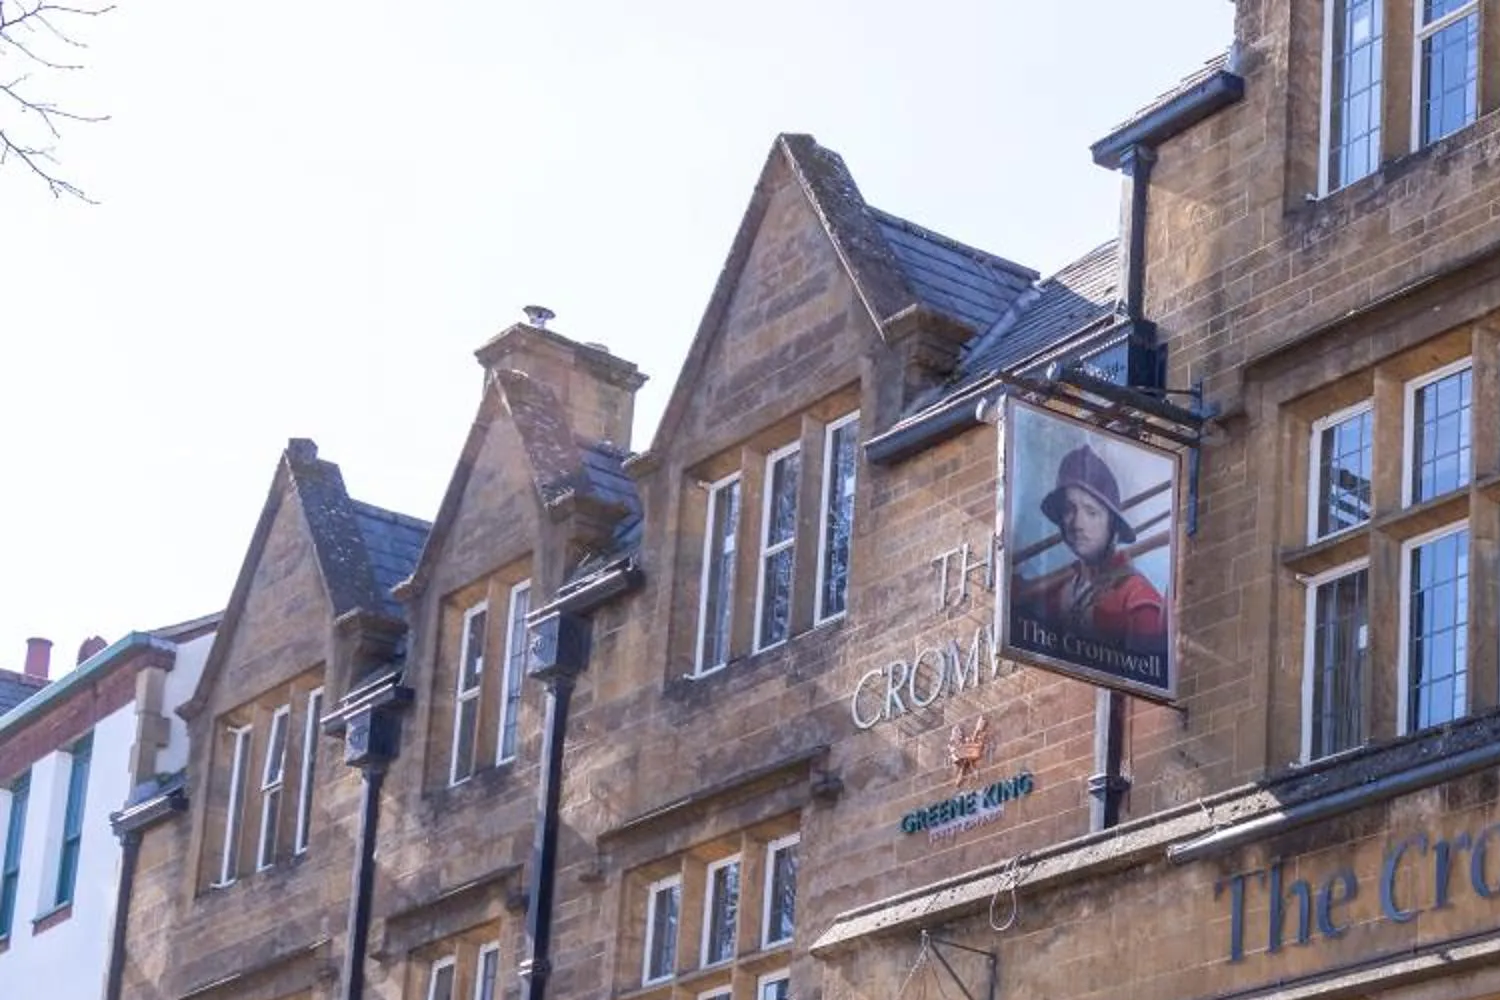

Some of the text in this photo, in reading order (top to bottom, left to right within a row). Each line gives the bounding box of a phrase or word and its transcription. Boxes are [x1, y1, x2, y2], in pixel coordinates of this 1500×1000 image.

[931, 533, 994, 611] TH
[1018, 616, 1058, 647] The
[852, 624, 999, 730] CROM
[901, 791, 977, 834] GREENE
[982, 771, 1034, 809] KING
[1214, 859, 1359, 963] The
